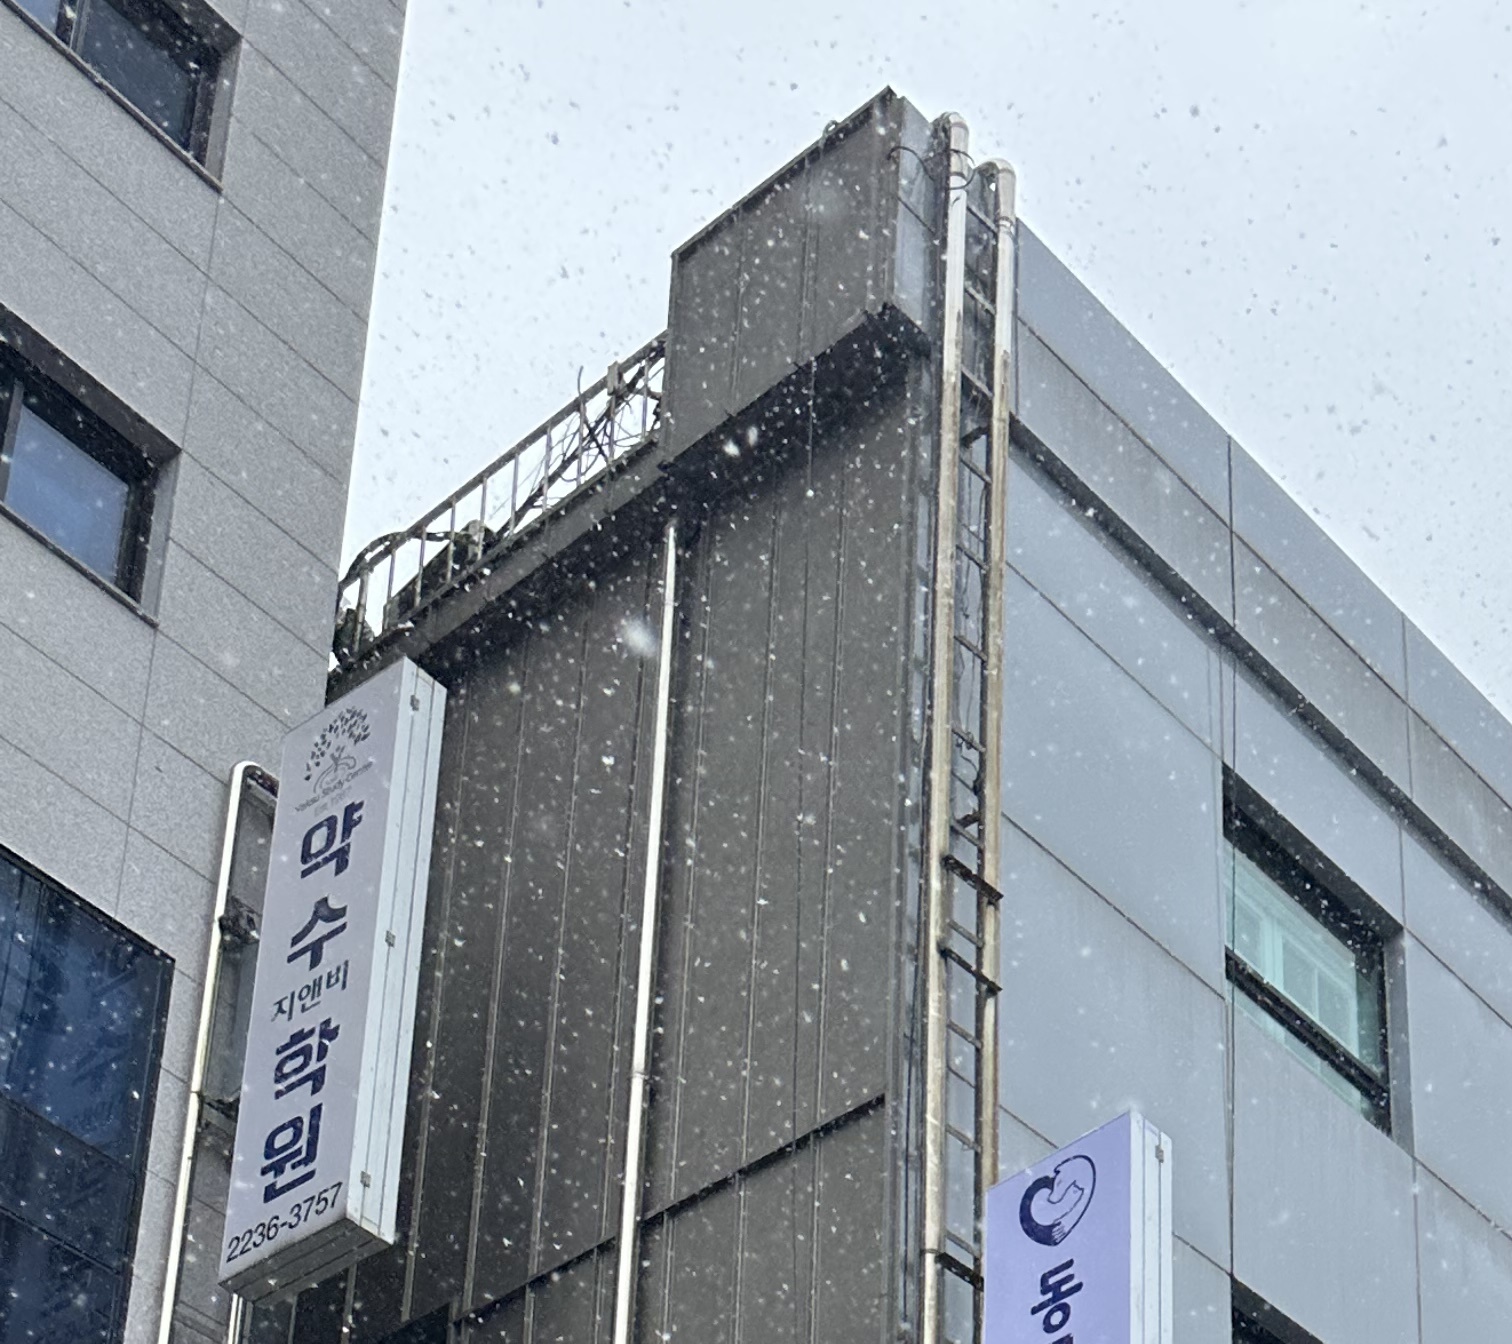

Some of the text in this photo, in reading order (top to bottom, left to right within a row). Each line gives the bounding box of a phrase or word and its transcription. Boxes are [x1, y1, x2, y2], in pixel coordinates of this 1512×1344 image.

[287, 799, 364, 971] 약수
[271, 960, 349, 1022] 지앤비
[261, 1015, 339, 1203] 학원
[226, 1182, 343, 1264] 2236-3757
